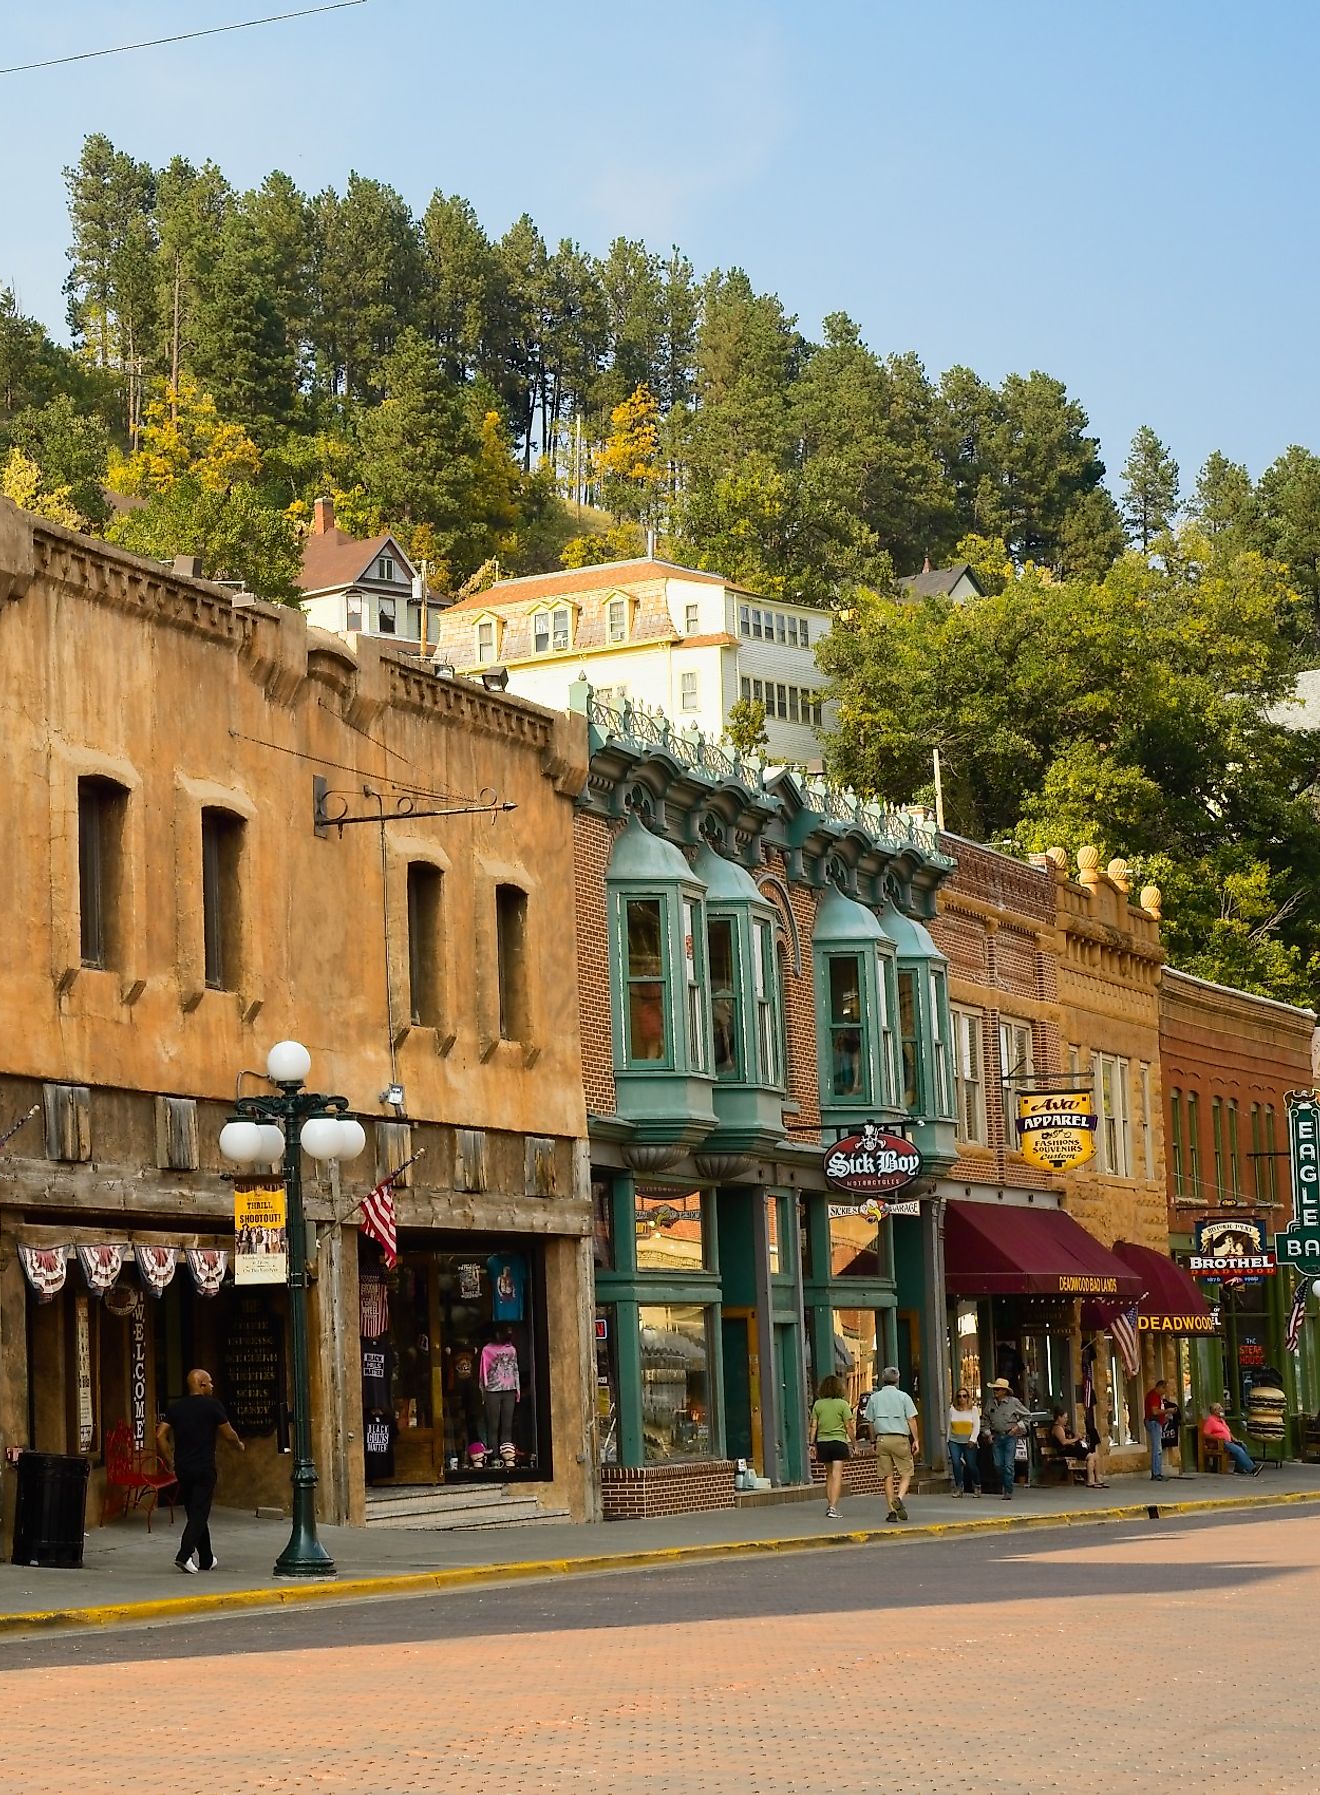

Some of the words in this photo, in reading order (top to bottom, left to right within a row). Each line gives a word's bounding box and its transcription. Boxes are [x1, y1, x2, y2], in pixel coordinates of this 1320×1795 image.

[1024, 1114, 1090, 1130] APPAREL
[1032, 1146, 1083, 1154] SOUVENIRS
[1034, 1139, 1080, 1147] FASHIONS
[826, 1151, 876, 1178] Sick
[876, 1150, 920, 1177] Boy
[1299, 1121, 1318, 1227] EAGLE
[846, 1179, 900, 1187] MOTORCYCLES
[239, 1213, 282, 1224] SHOOTOUT!
[1189, 1255, 1274, 1270] BROTHEL
[1059, 1276, 1090, 1292] DEADWOOD
[1137, 1315, 1213, 1331] DEADWOOD
